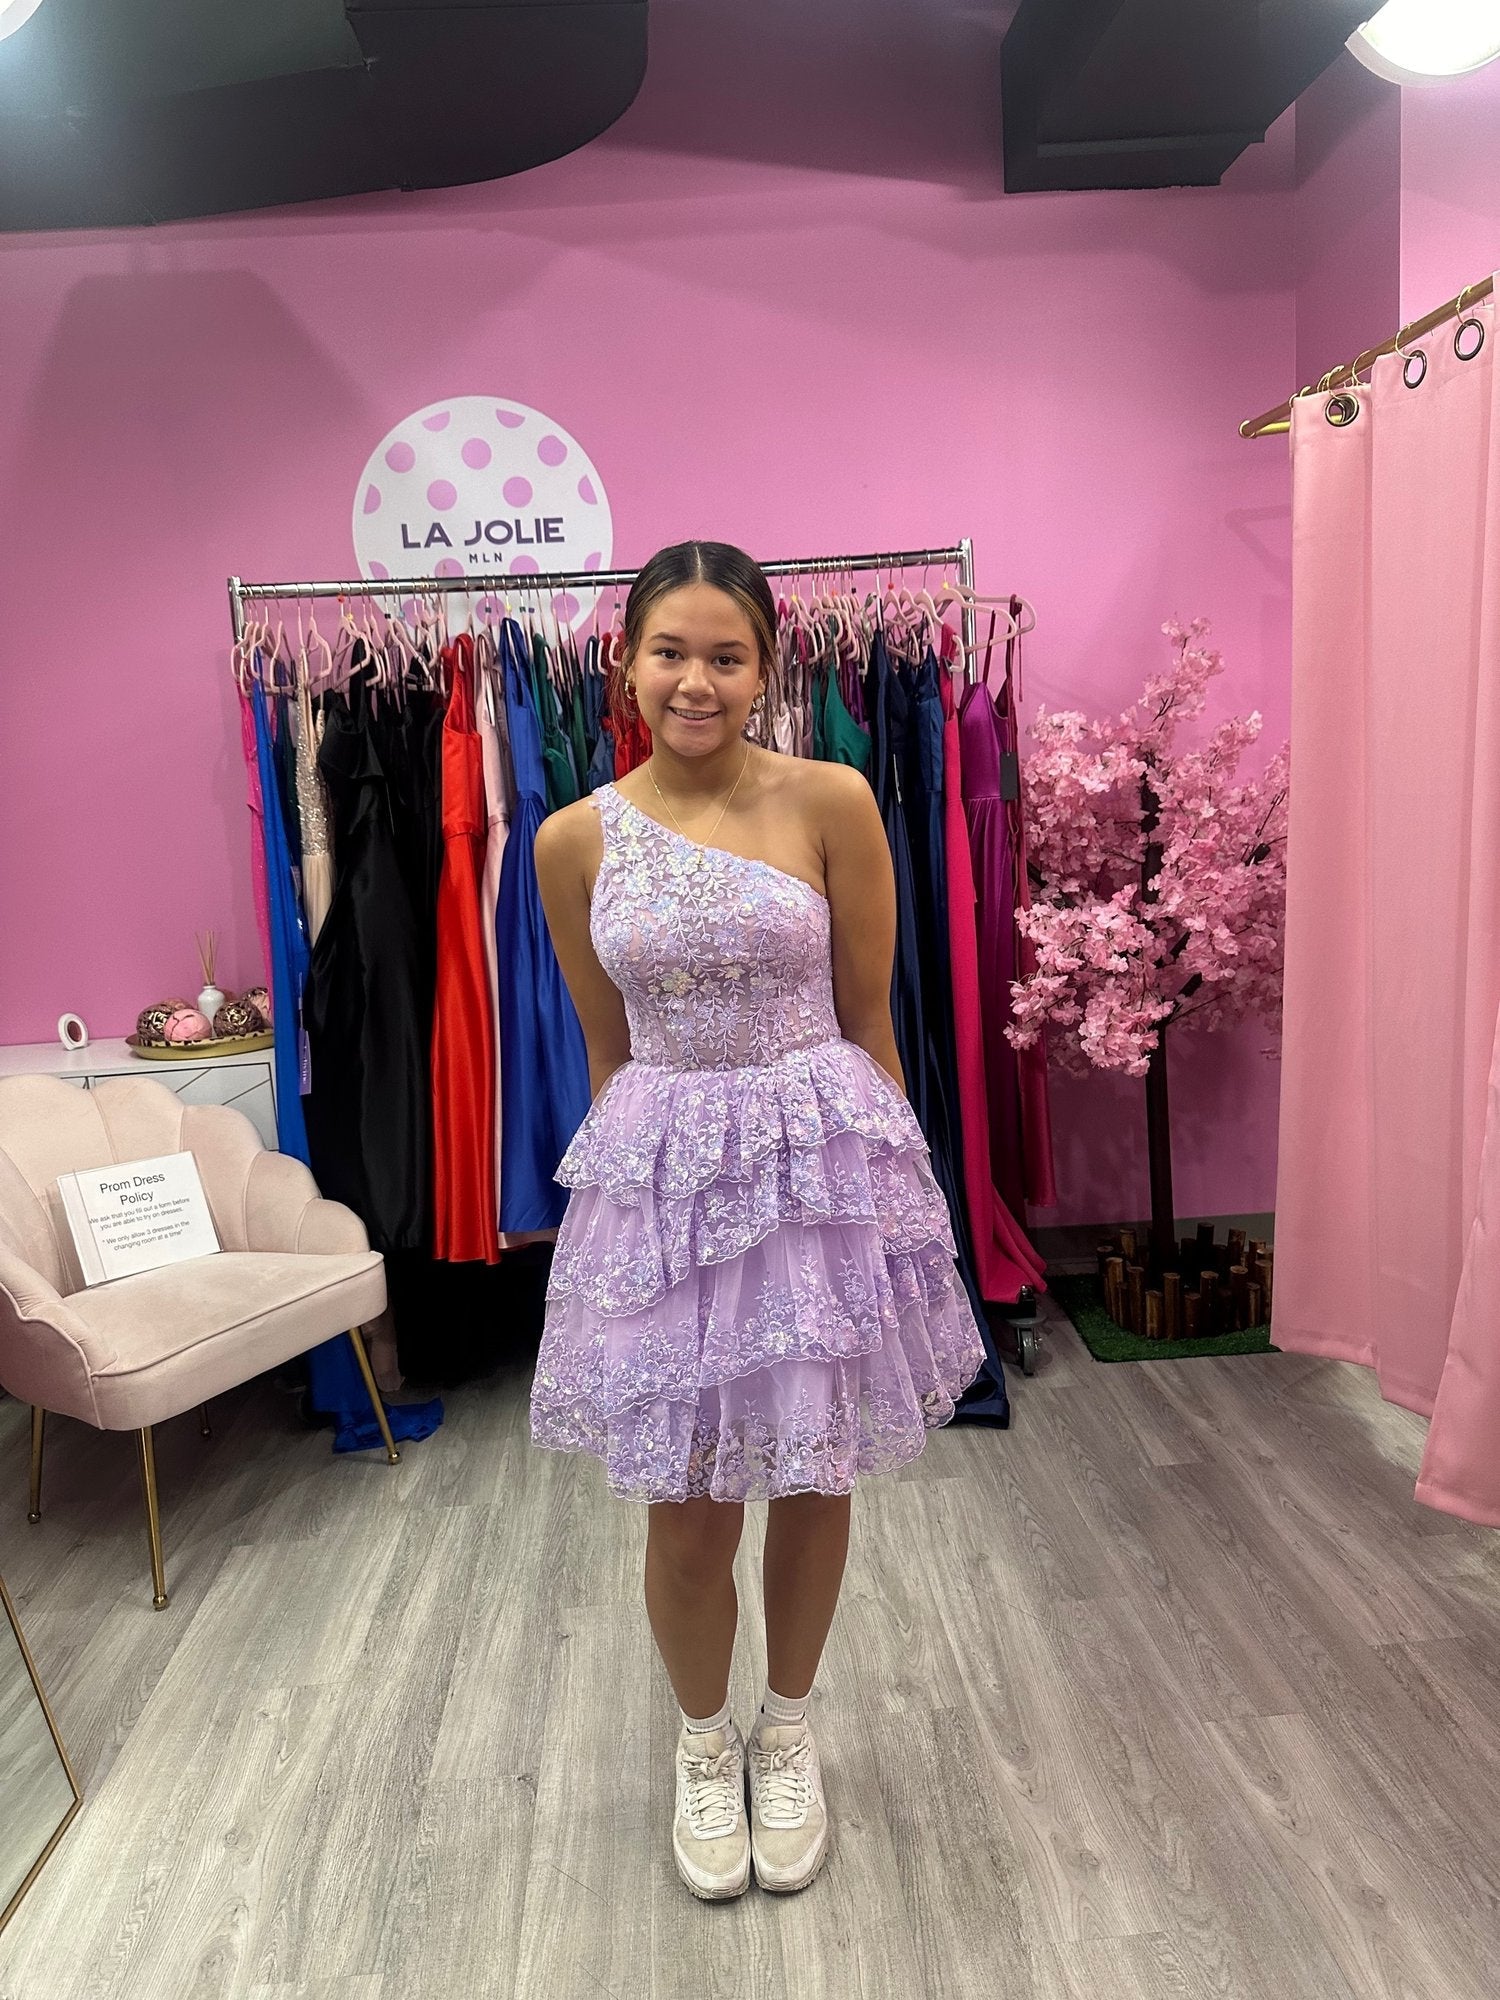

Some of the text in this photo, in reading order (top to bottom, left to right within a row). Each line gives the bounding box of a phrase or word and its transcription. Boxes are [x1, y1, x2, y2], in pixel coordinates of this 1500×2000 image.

[401, 517, 565, 549] LA JOLIE
[469, 552, 503, 563] MLN
[100, 1172, 166, 1194] Prom Dress
[111, 1211, 123, 1219] that
[124, 1209, 135, 1217] you
[143, 1204, 153, 1212] out
[158, 1201, 172, 1209] form
[172, 1197, 190, 1206] before
[120, 1191, 154, 1206] Policy
[123, 1217, 135, 1225] able
[113, 1240, 141, 1251] changing
[141, 1236, 157, 1244] room
[157, 1233, 164, 1241] at
[117, 1235, 130, 1243] only
[131, 1231, 146, 1239] allow
[151, 1223, 174, 1234] dresses
